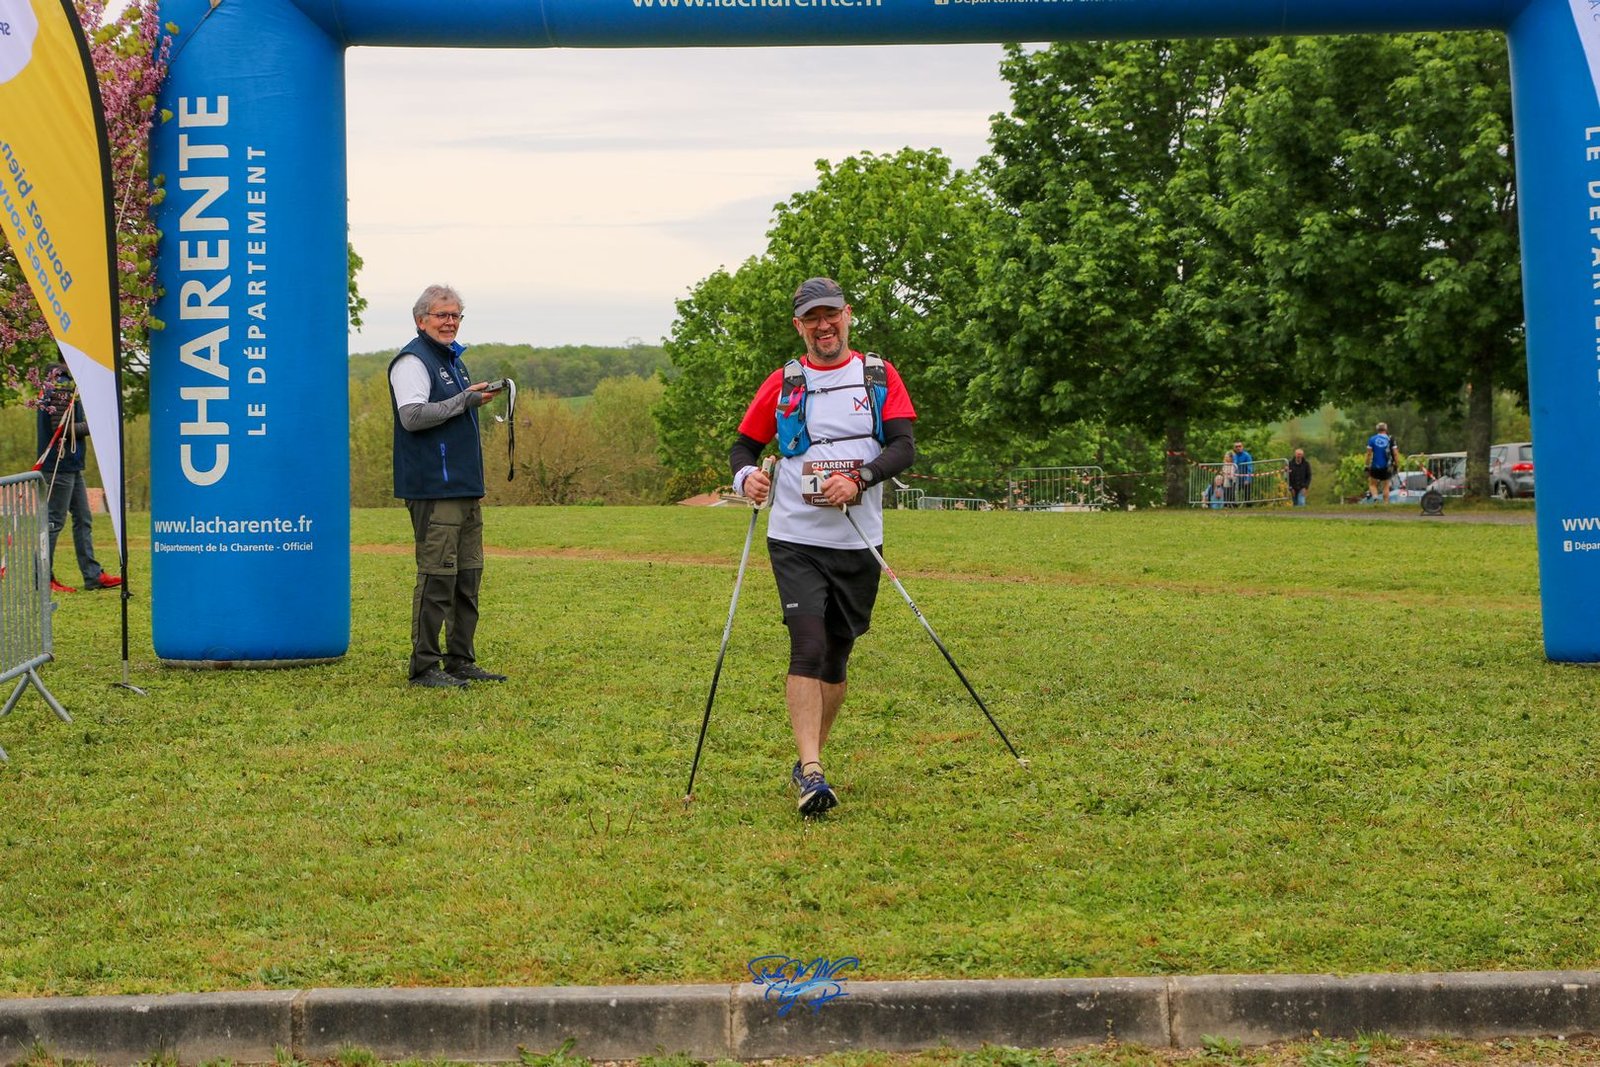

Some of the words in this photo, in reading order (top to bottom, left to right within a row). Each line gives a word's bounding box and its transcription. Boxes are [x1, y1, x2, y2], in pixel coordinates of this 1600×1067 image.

[243, 146, 266, 384] DÉPARTEMENT
[178, 95, 231, 486] CHARENTE
[248, 403, 266, 436] LE
[811, 461, 855, 469] CHARENTE
[154, 515, 313, 533] www.lacharente.fr
[160, 543, 203, 553] Département
[206, 543, 217, 552] de
[219, 543, 228, 552] la
[231, 543, 275, 552] Charente
[282, 541, 313, 551] Officiel
